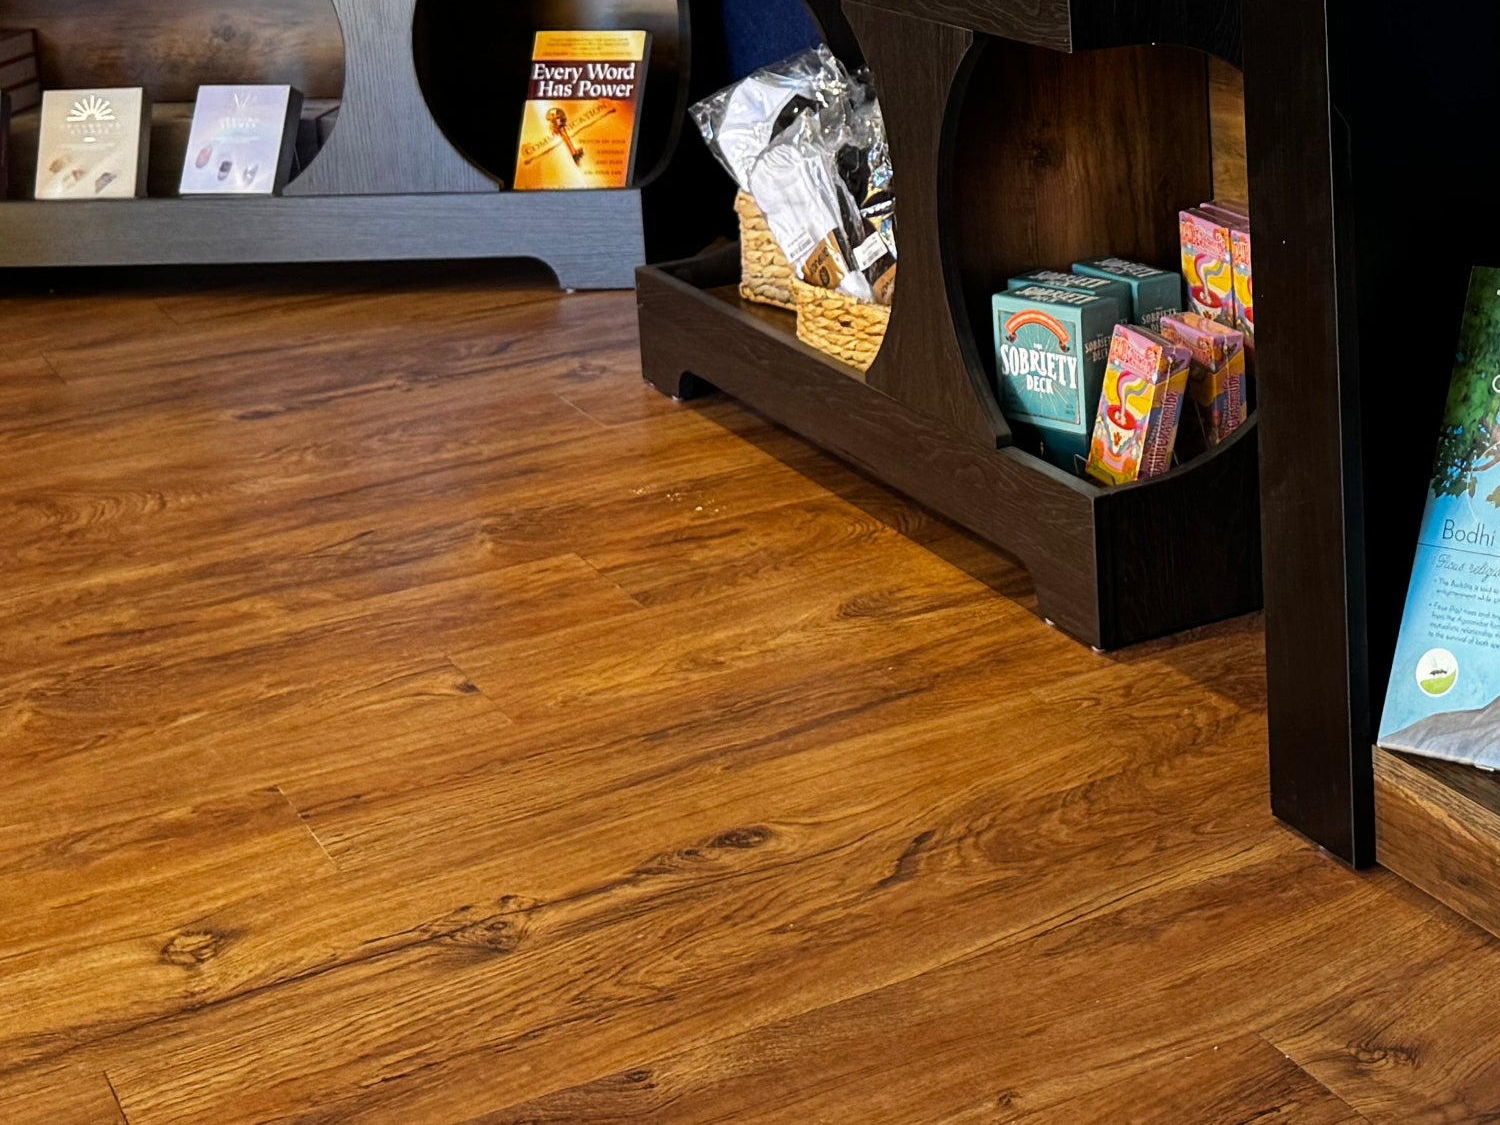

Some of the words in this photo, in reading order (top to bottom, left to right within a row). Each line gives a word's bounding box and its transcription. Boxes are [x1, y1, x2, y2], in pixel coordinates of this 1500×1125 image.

[532, 63, 583, 85] Every
[588, 62, 636, 81] Word
[537, 80, 573, 97] Has
[578, 80, 634, 98] Power
[1000, 344, 1078, 390] SOBRIETY
[1026, 374, 1055, 396] DECK
[1442, 518, 1497, 547] Bodhi
[1435, 553, 1465, 572] Ficus
